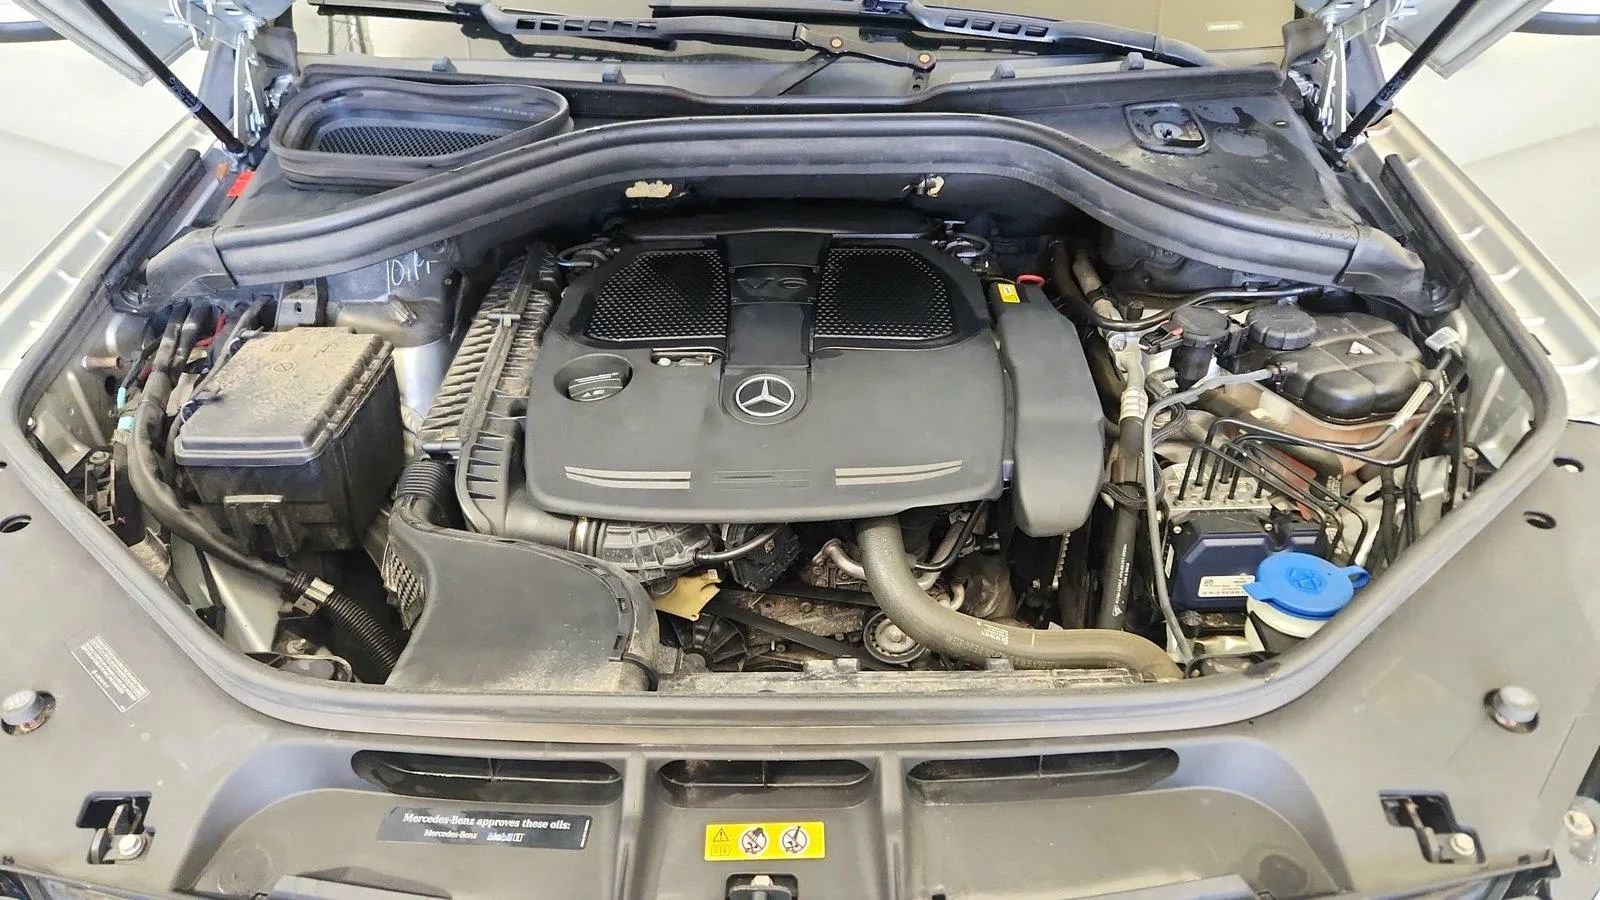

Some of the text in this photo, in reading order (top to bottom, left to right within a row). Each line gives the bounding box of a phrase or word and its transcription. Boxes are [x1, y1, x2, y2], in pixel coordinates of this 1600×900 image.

[402, 812, 571, 830] Mercedes-Benz approves these oils:
[423, 829, 478, 839] Mercedes-Benz
